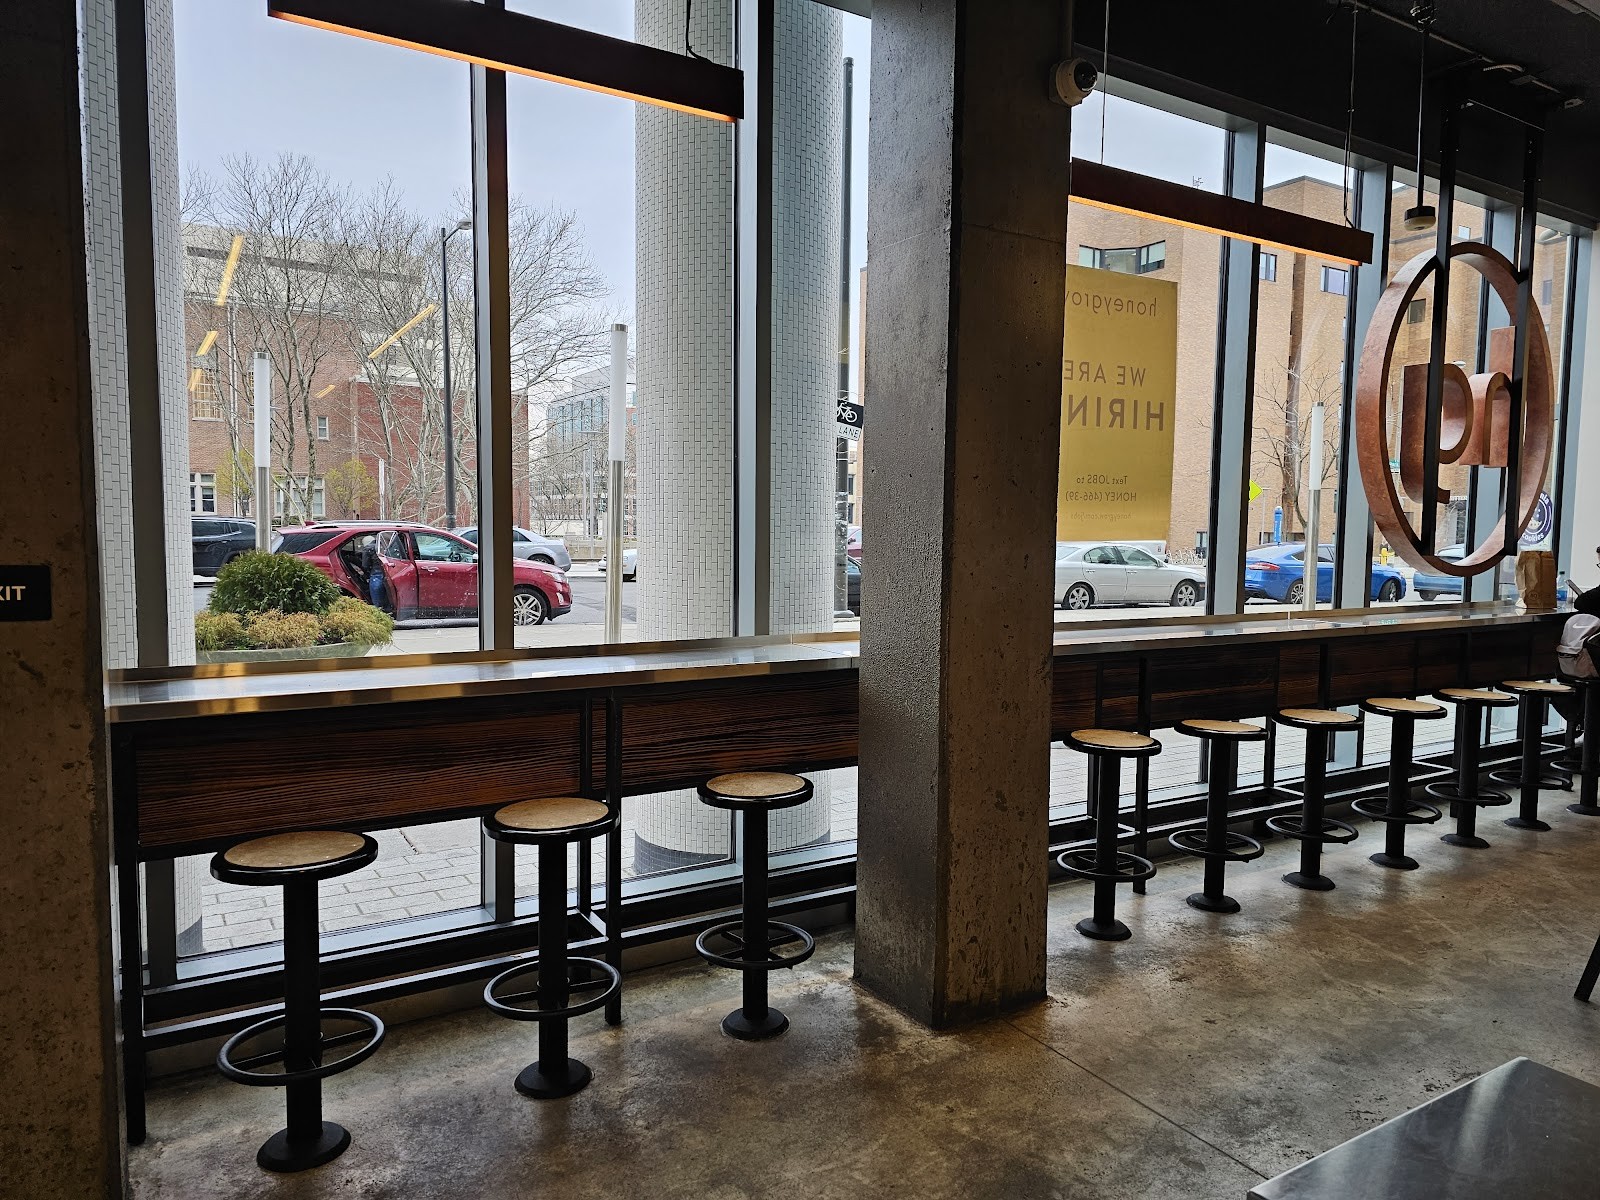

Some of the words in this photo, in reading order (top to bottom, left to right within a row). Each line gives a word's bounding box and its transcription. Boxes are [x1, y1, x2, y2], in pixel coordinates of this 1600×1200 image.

[839, 426, 859, 438] LANE
[1522, 532, 1545, 542] cookies
[0, 585, 26, 601] IT
